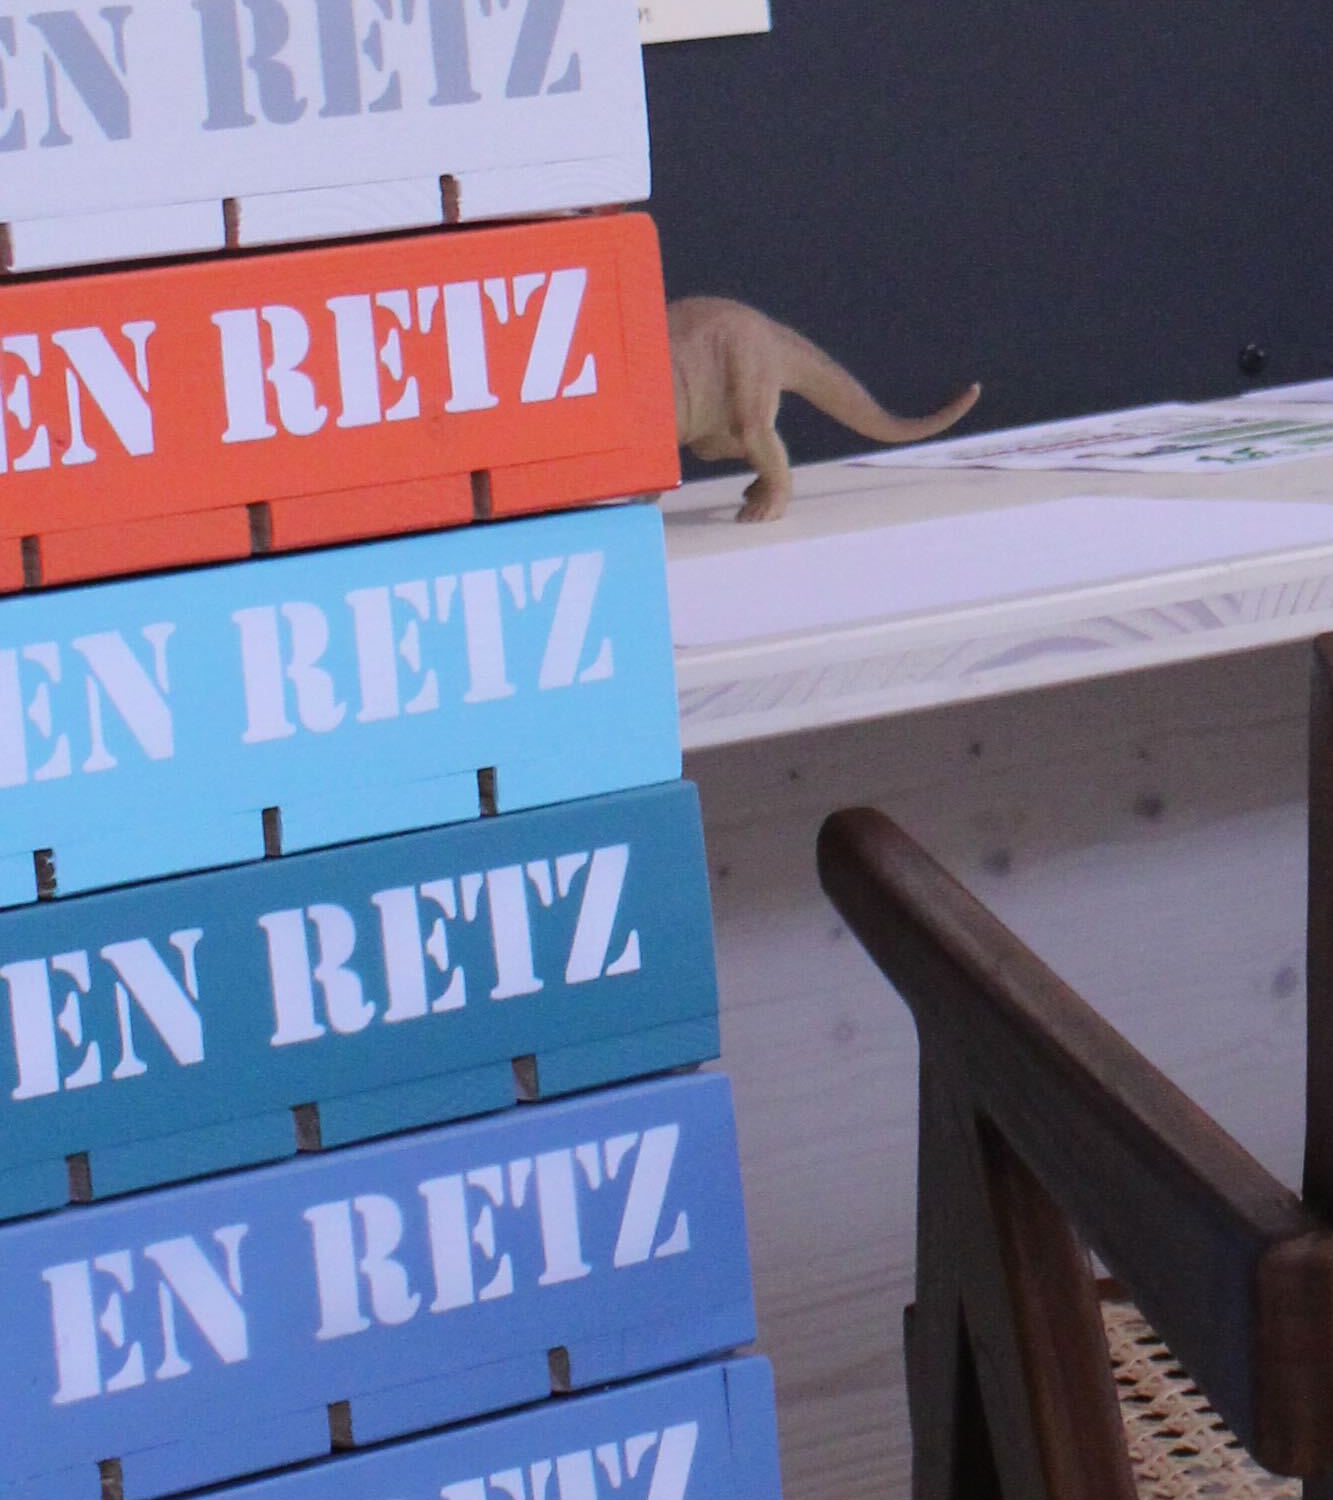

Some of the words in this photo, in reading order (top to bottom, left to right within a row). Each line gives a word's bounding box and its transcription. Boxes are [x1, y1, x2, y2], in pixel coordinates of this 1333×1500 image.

[0, 5, 134, 151] N
[211, 267, 598, 444] RETZ
[0, 622, 176, 787] EN
[233, 550, 614, 743] RETZ
[0, 928, 204, 1100] EN
[257, 843, 641, 1046] RETZ
[41, 1223, 250, 1404] EN
[303, 1123, 692, 1341] RETZ
